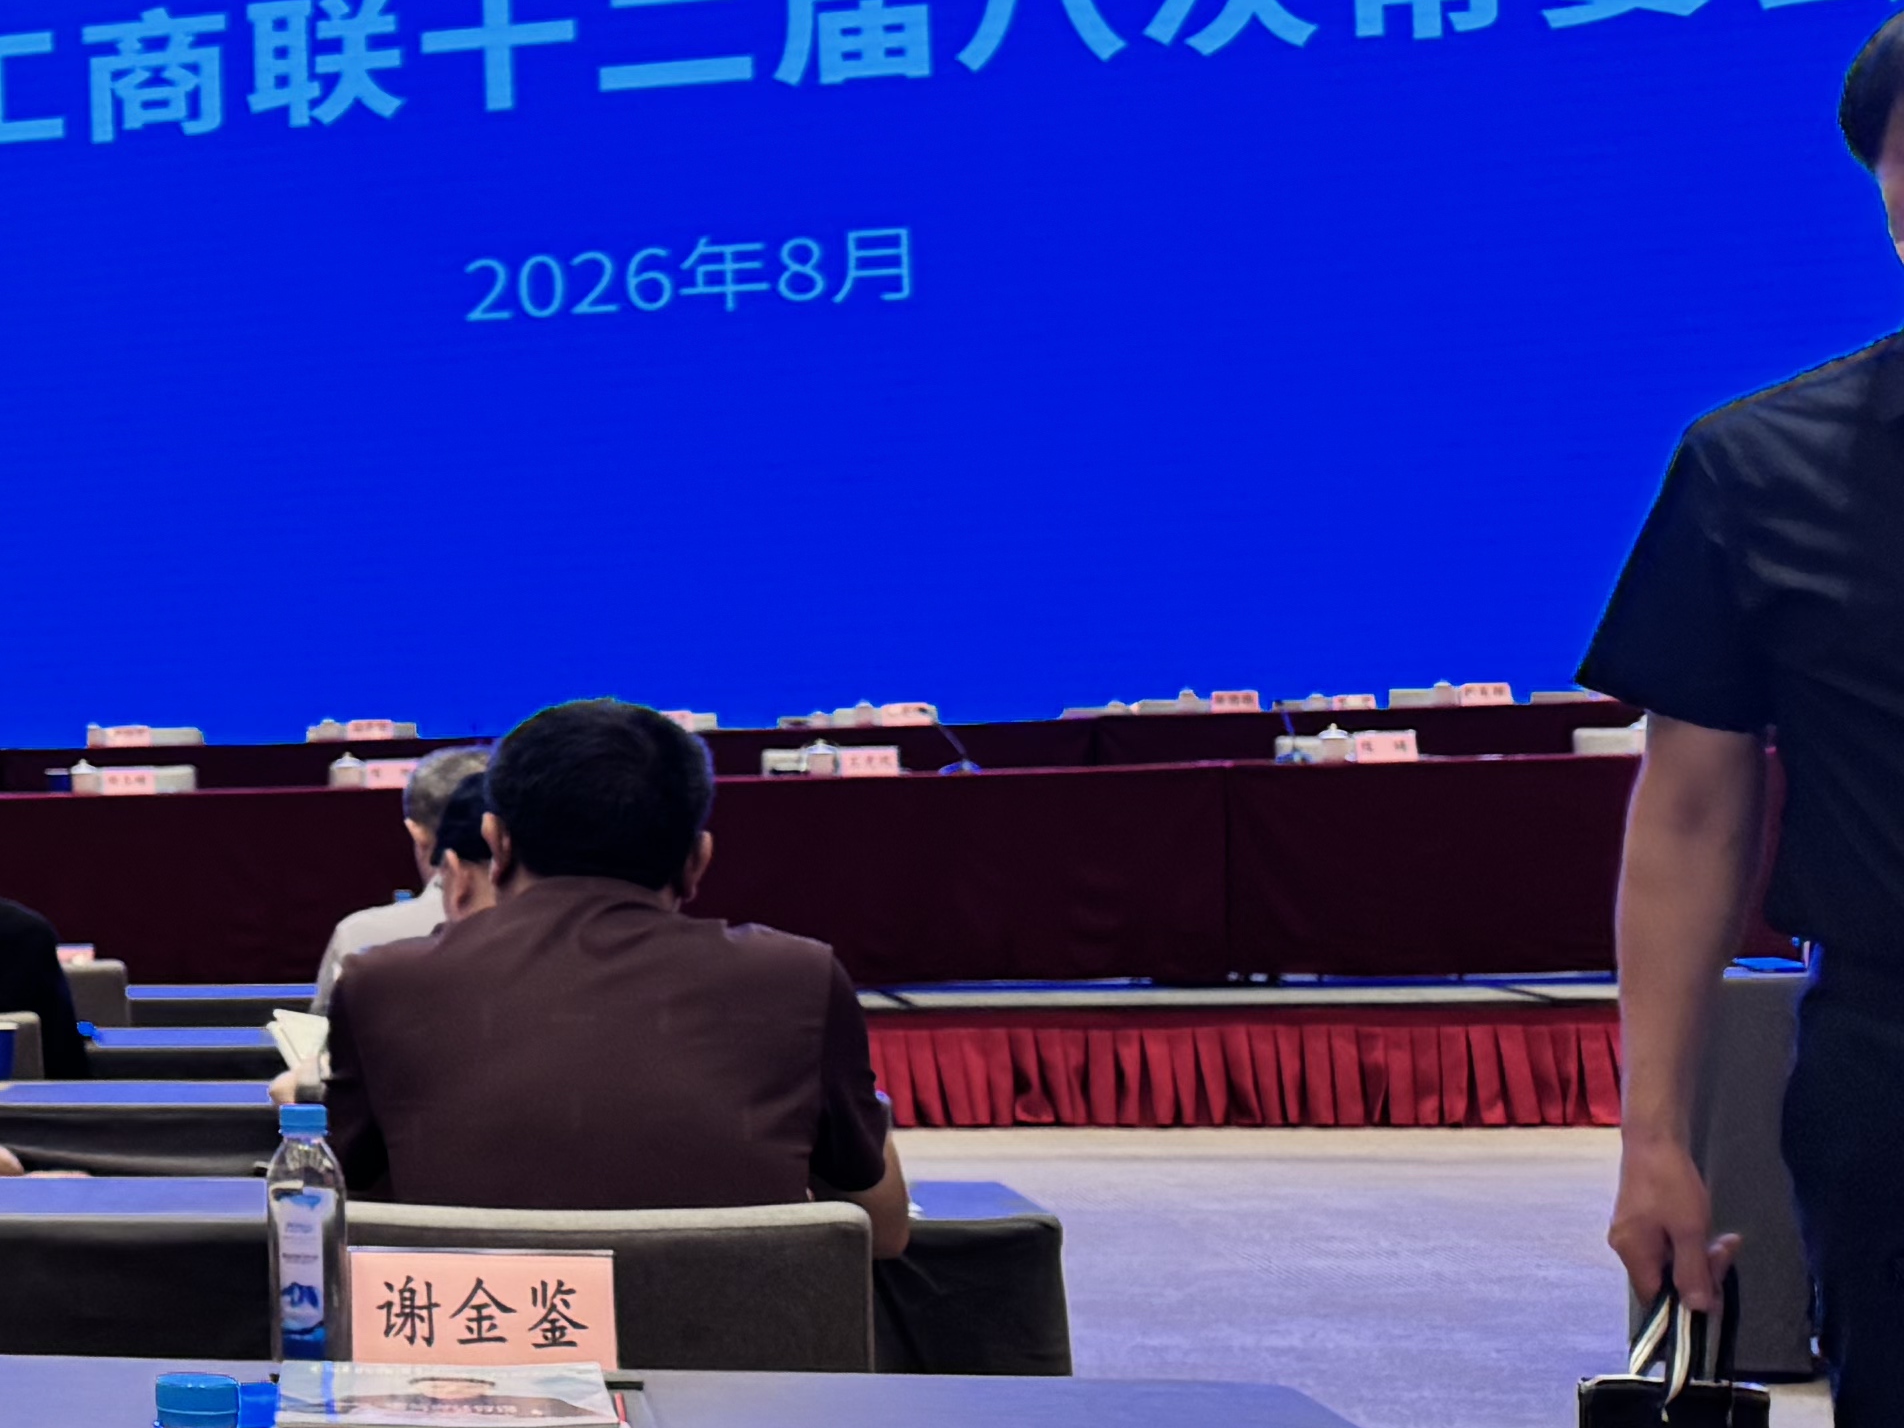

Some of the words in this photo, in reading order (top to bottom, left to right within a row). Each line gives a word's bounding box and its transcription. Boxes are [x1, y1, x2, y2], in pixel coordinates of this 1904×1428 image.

[464, 228, 911, 322] 2026年8月
[376, 1274, 590, 1350] 谢金鉴
